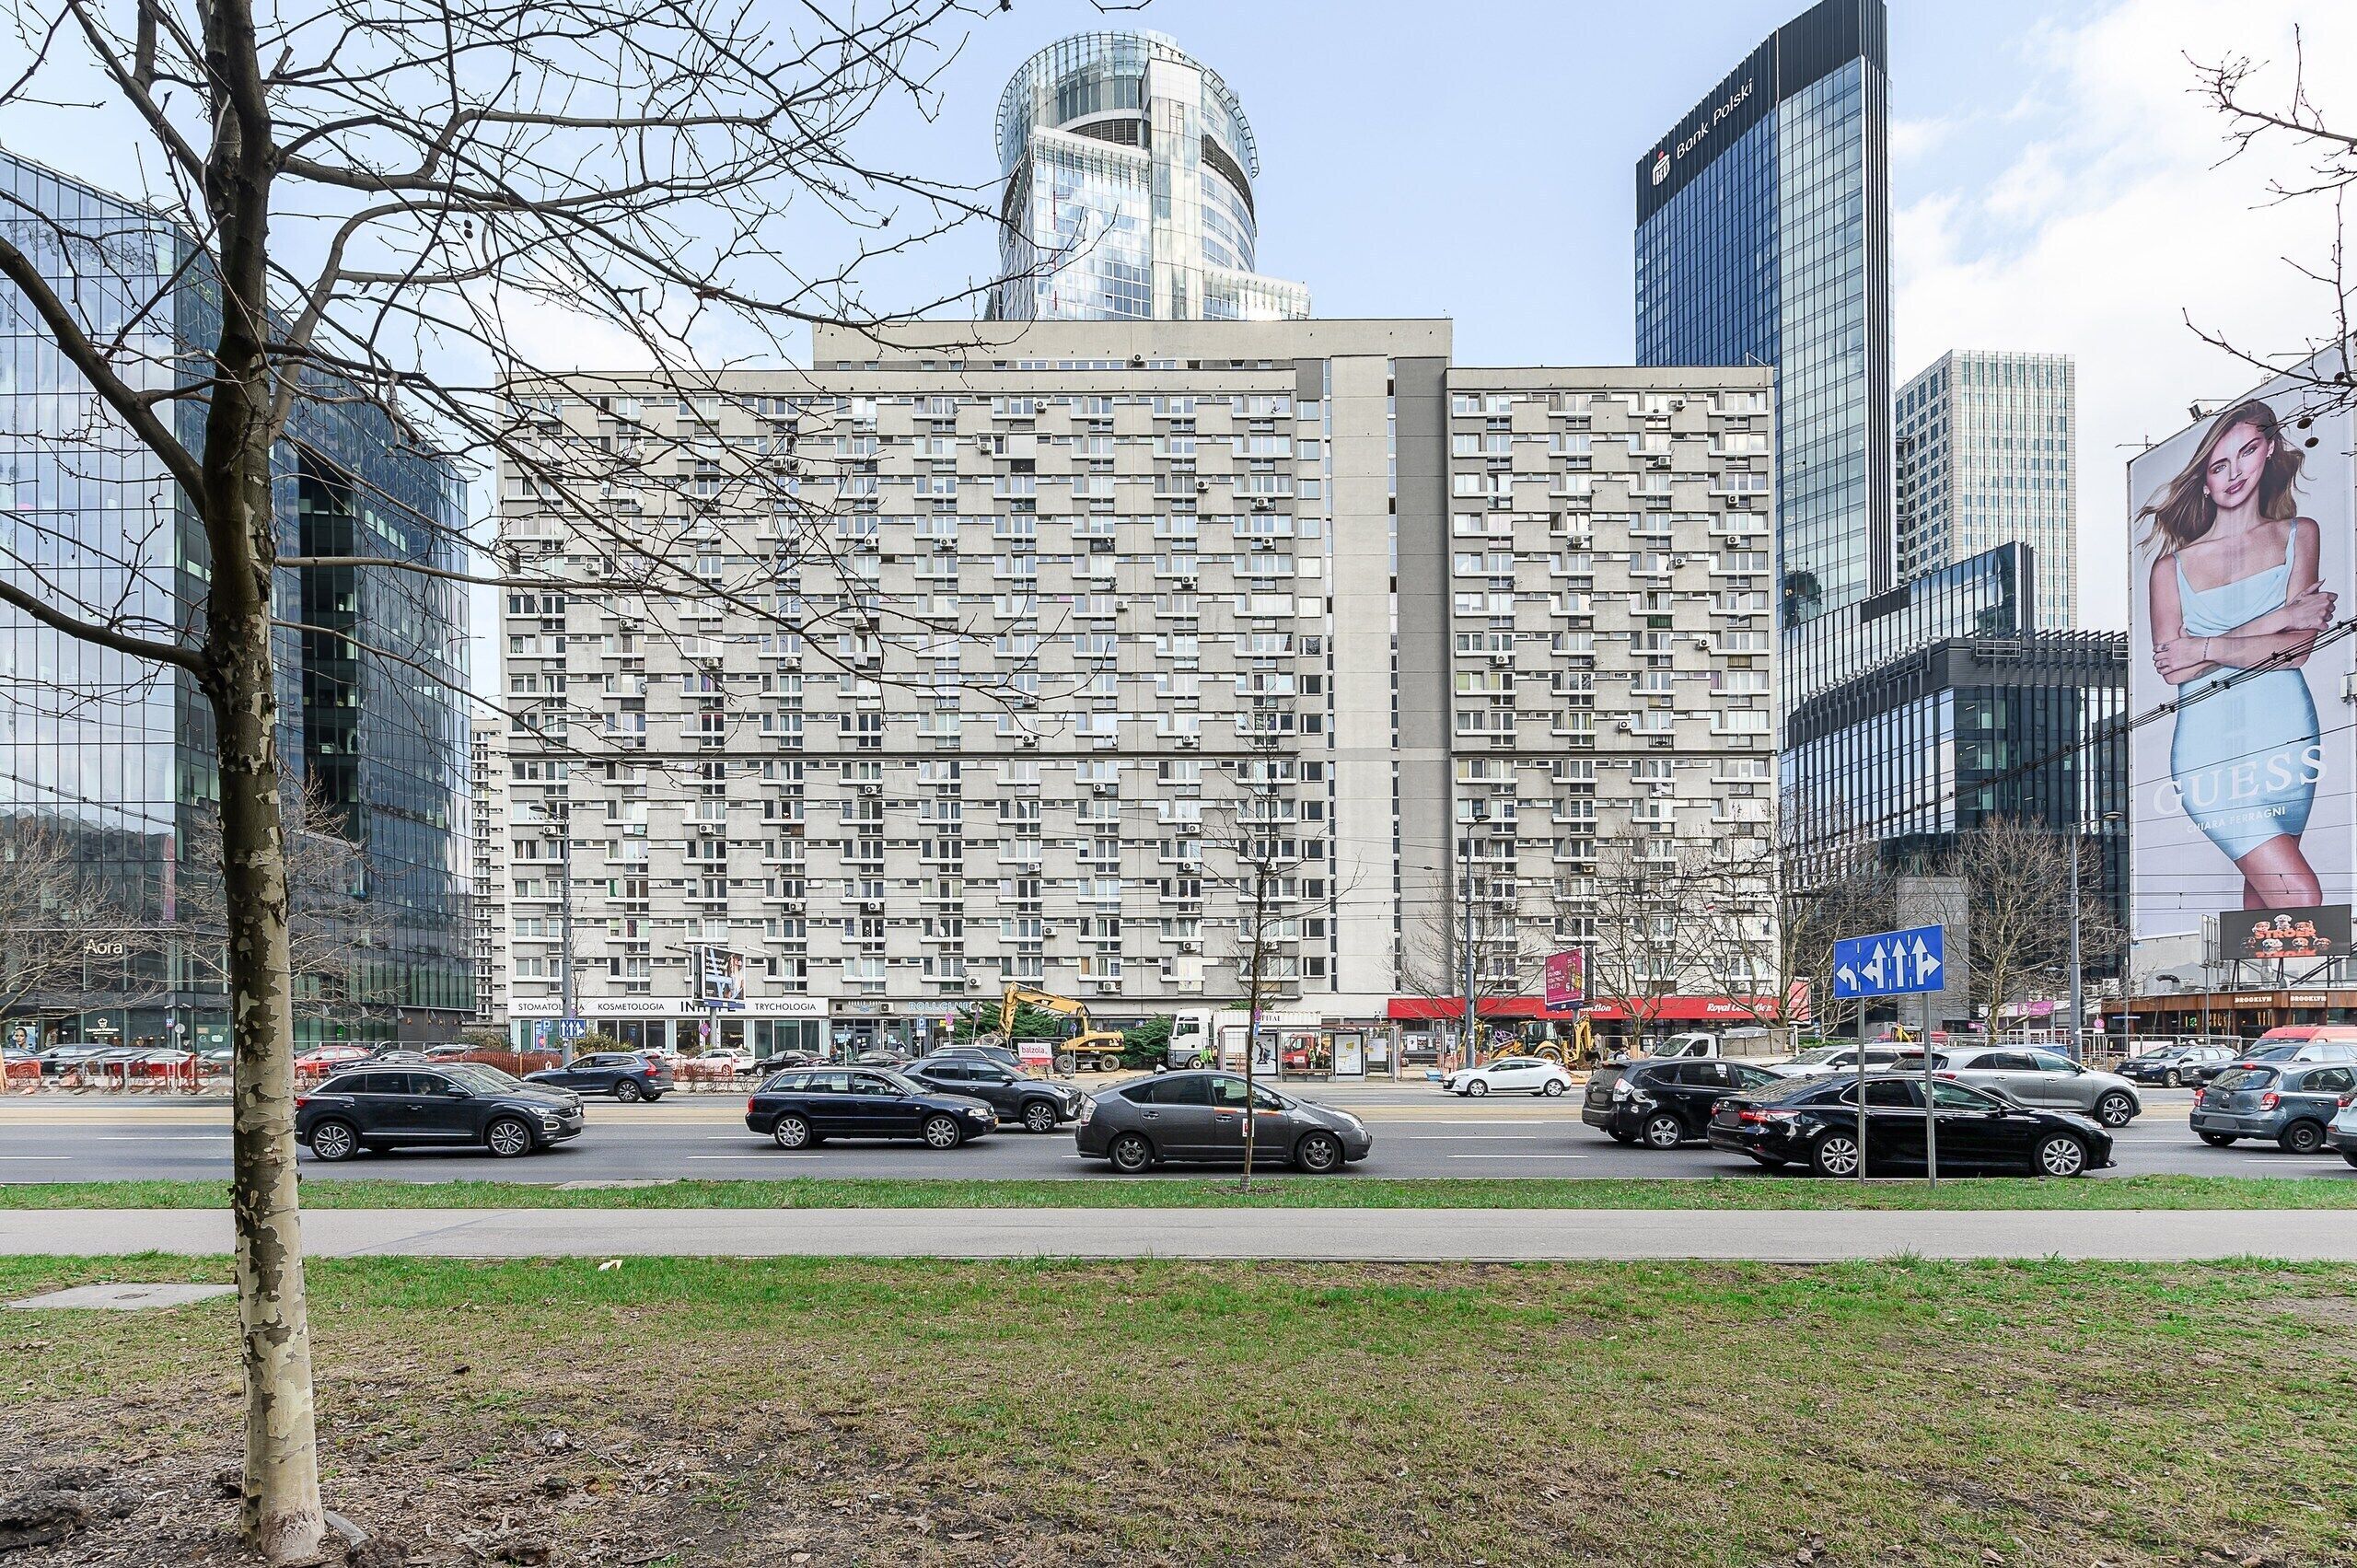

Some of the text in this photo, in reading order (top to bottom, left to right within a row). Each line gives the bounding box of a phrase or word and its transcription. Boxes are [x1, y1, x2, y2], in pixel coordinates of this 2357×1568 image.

[1677, 122, 1709, 160] Bank
[1713, 78, 1753, 127] Polski
[2153, 744, 2328, 816] GUESS
[2187, 806, 2286, 833] CHIARA FERRAGNI
[84, 939, 122, 955] Aora
[598, 1003, 665, 1011] KOSMETOLOGIA
[754, 1003, 817, 1011] TRYCHOLOGIA
[908, 1001, 970, 1011] ROLL CLUB
[1707, 1003, 1730, 1013] Royal
